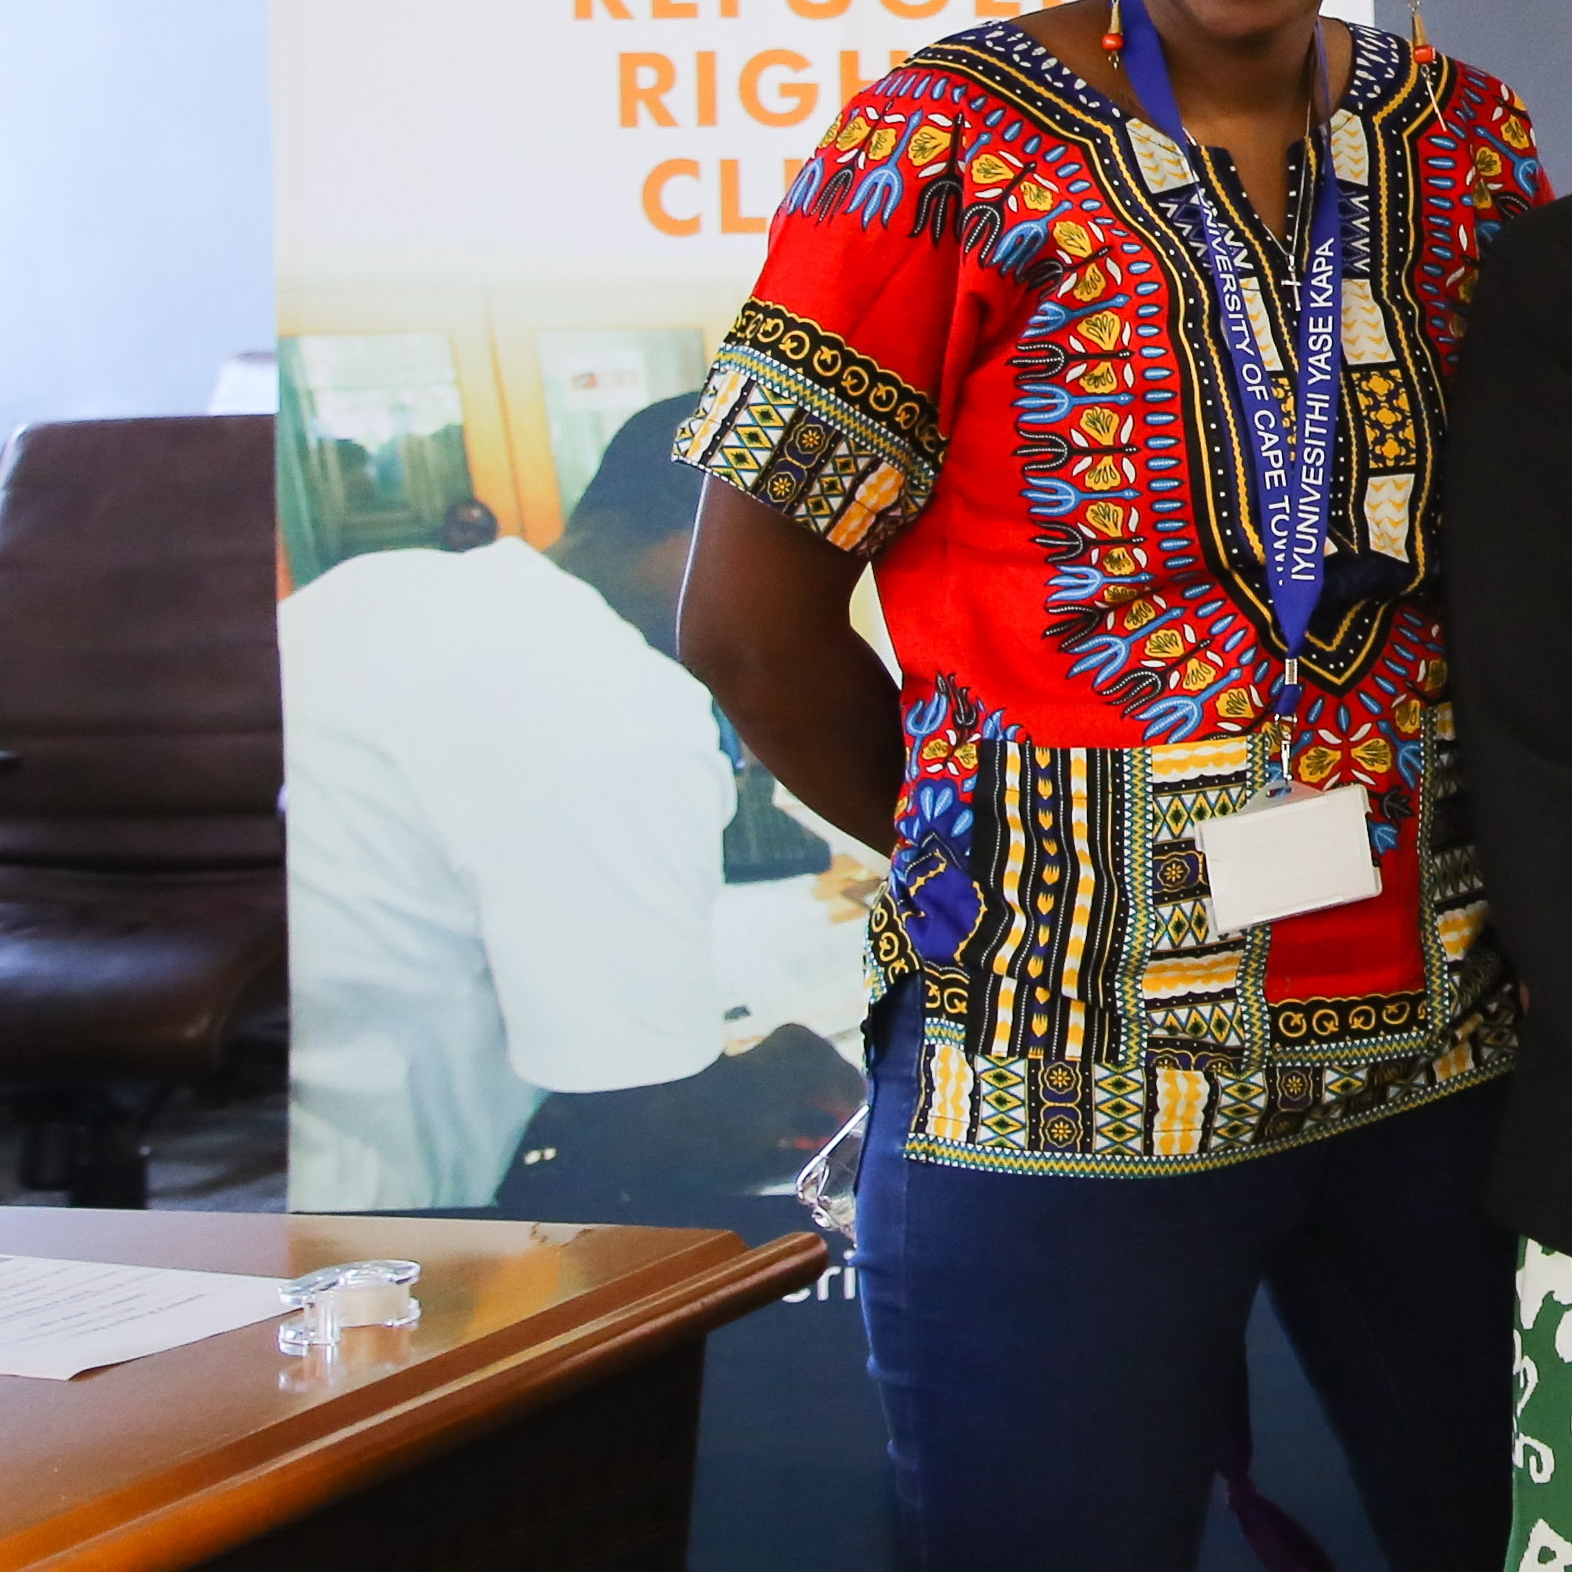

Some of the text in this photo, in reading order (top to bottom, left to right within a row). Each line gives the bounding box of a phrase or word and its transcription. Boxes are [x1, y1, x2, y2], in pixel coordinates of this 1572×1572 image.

[1240, 362, 1270, 402] OF
[1290, 236, 1336, 582] IYUNIVESITHI YASE KAPA
[1253, 409, 1288, 490] CAPE
[1268, 493, 1291, 586] TOW
